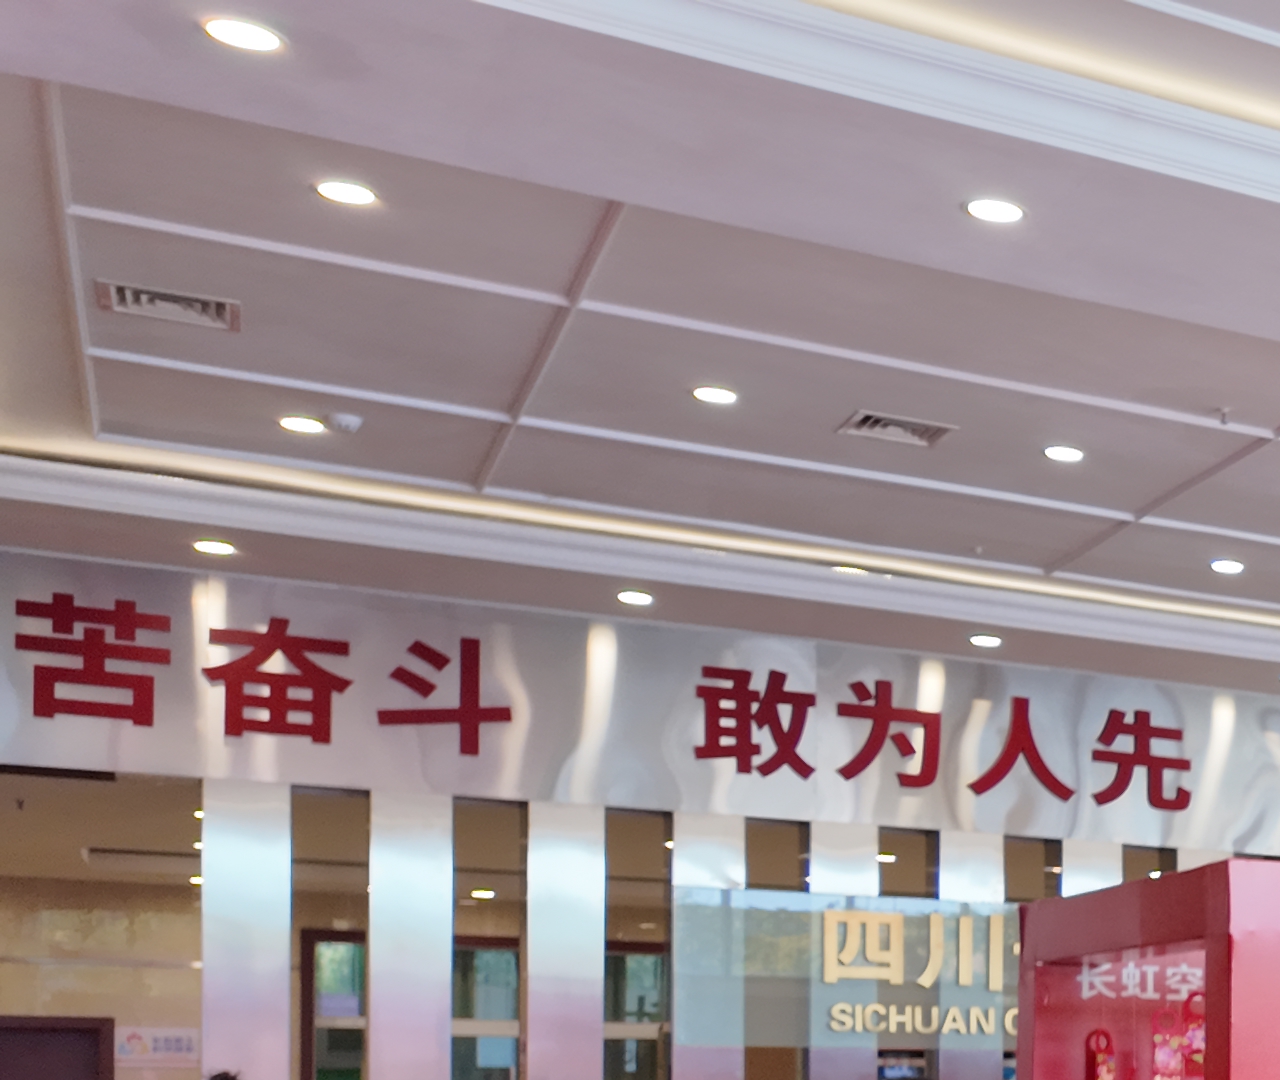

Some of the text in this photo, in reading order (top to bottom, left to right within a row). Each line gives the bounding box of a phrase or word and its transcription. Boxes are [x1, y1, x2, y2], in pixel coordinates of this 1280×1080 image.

[14, 592, 513, 756] 苦奋斗
[694, 666, 1192, 812] 敢为人先
[823, 911, 1020, 991] 四川
[829, 1002, 996, 1035] SICHUAN
